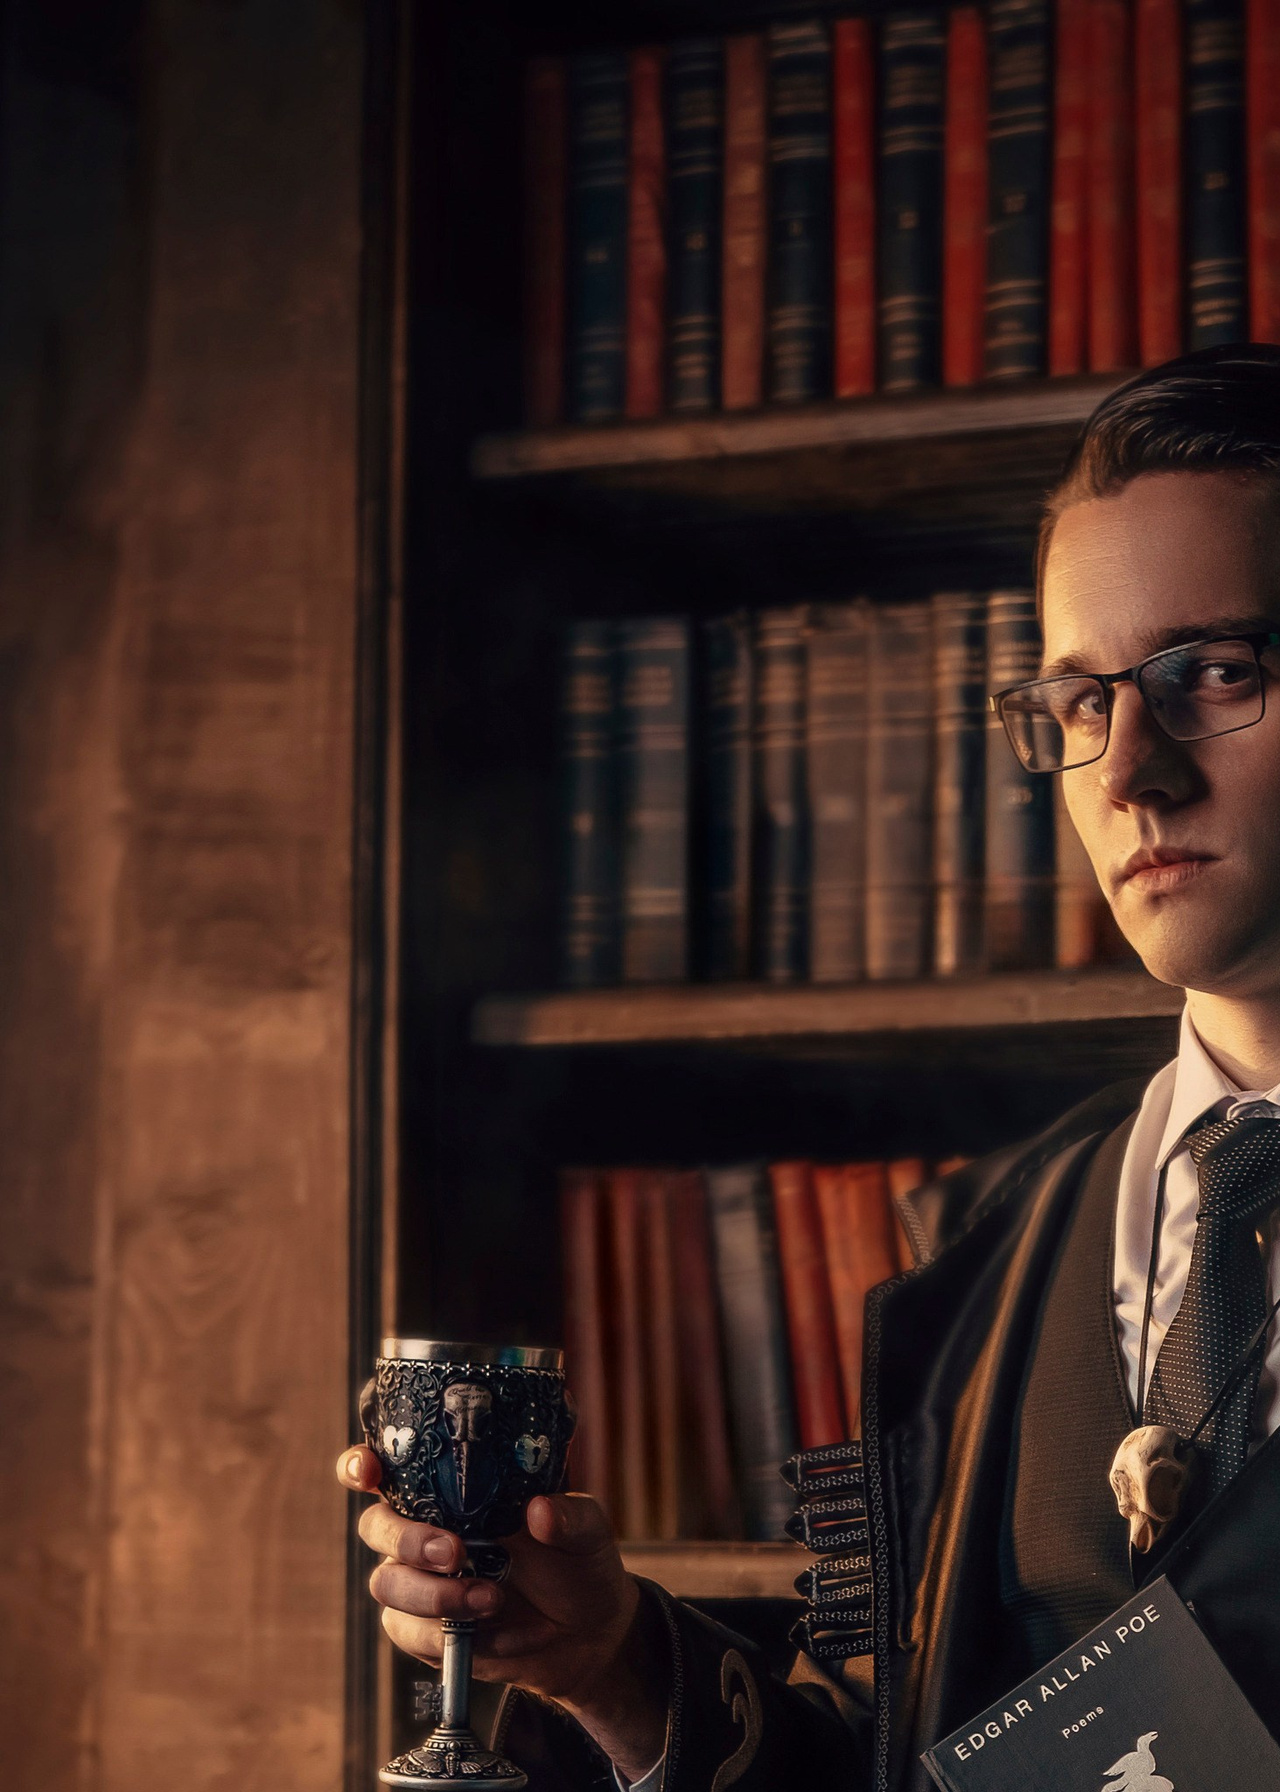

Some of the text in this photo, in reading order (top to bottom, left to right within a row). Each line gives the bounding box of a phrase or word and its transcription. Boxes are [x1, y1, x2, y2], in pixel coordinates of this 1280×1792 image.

[954, 1604, 1161, 1761] EDGAR ALLAN POE
[1062, 1705, 1105, 1739] Poems
